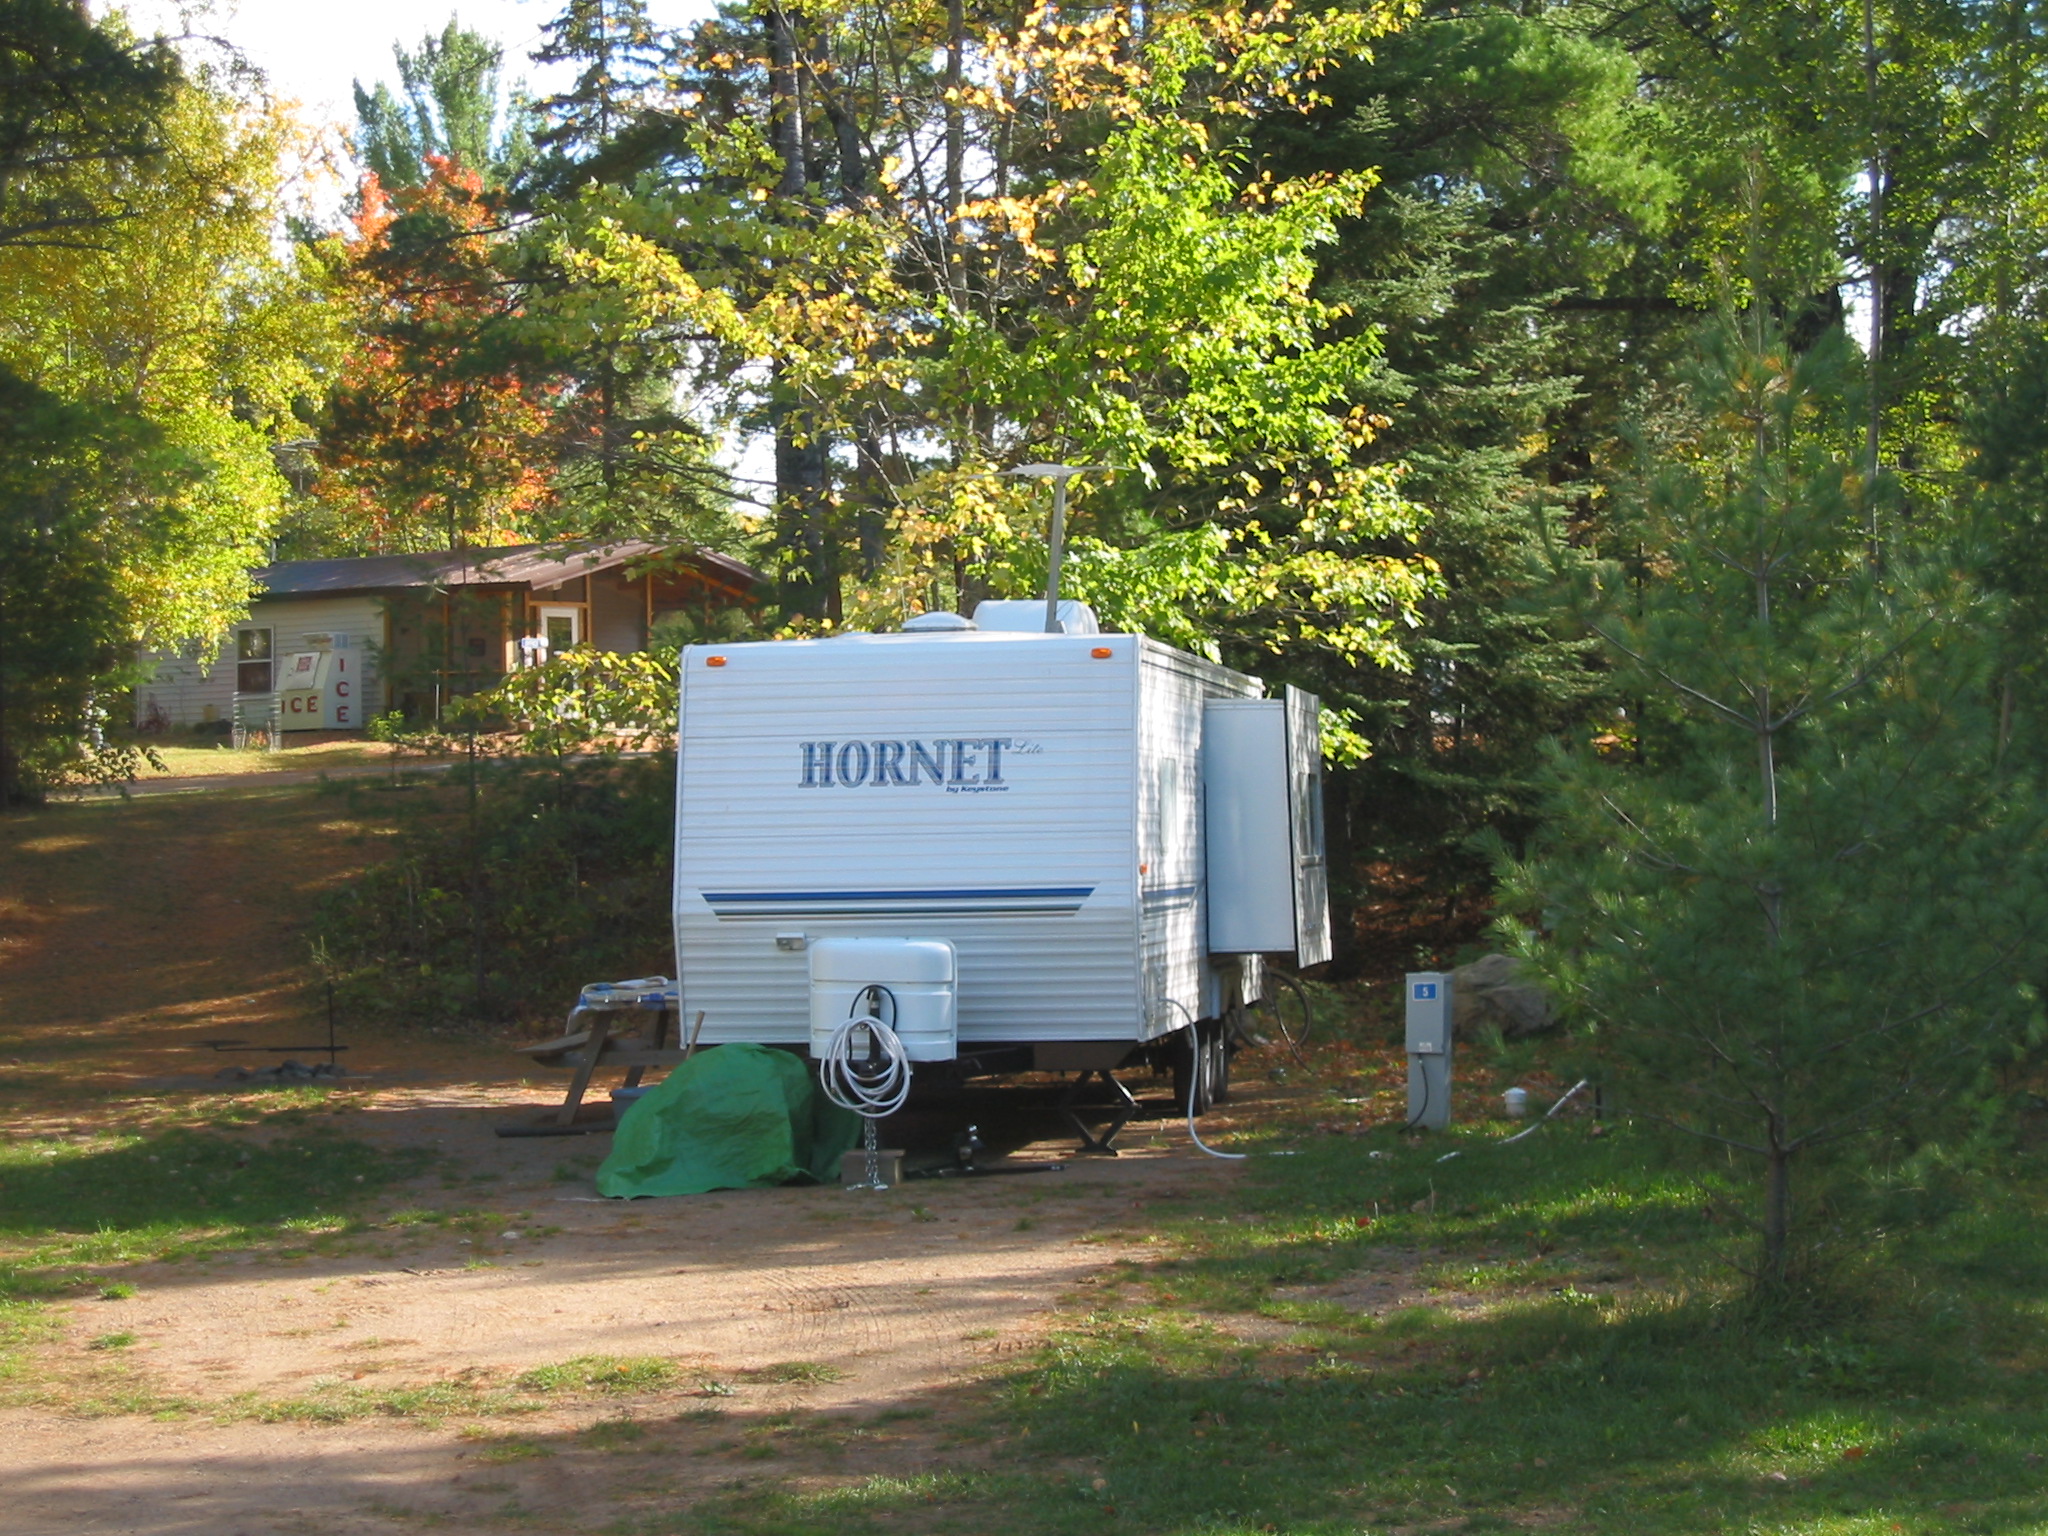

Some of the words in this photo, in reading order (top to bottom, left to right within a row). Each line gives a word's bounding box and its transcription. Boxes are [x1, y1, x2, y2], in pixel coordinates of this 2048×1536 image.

[281, 695, 318, 714] ICE
[798, 737, 1012, 788] HORNET
[961, 785, 1009, 793] Keystone
[1422, 986, 1429, 997] 5
